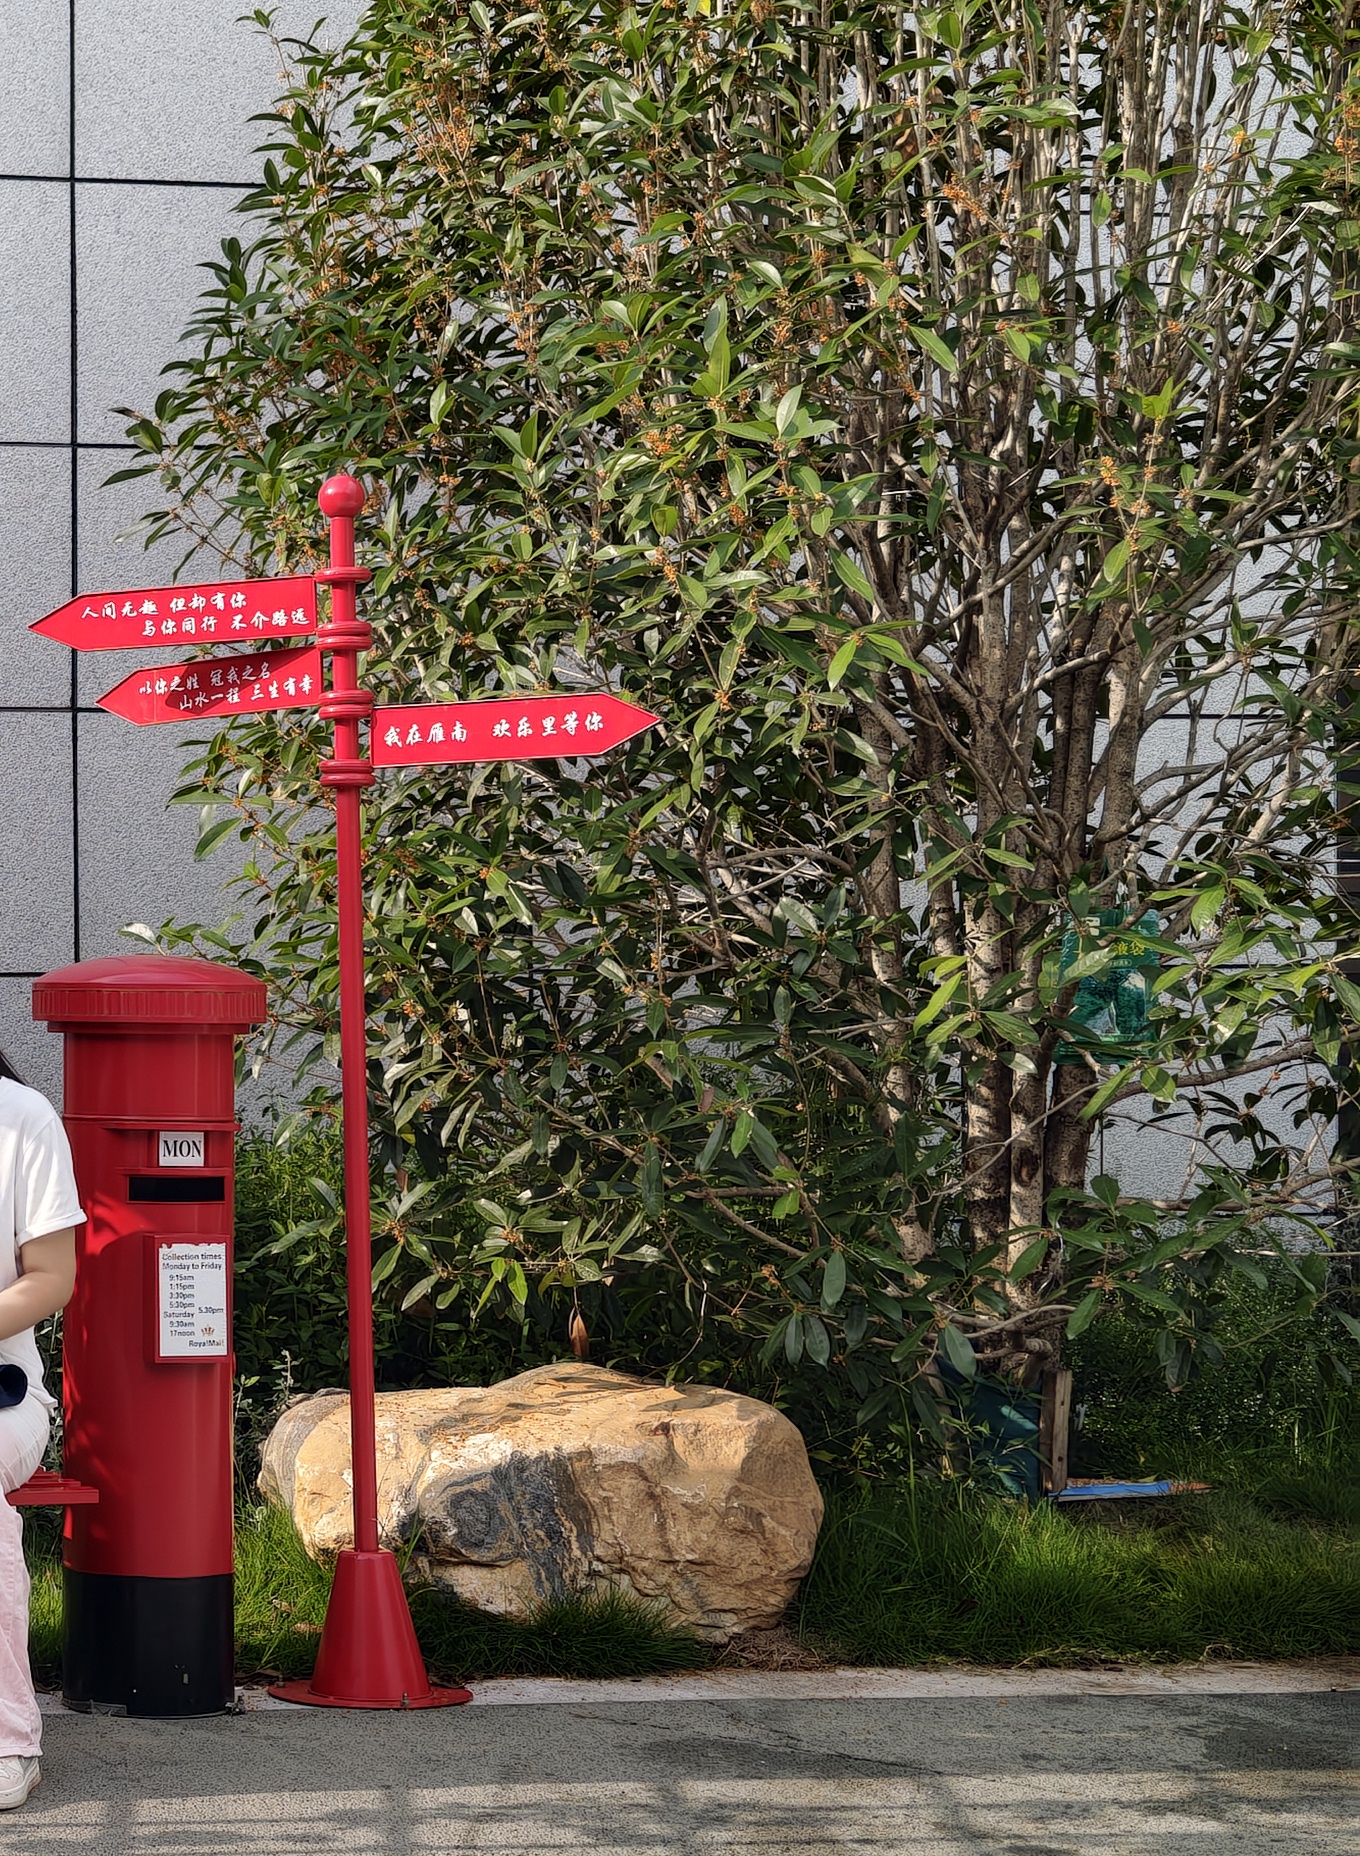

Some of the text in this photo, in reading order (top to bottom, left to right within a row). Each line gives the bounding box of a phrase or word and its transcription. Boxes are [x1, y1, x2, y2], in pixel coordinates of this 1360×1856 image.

[169, 591, 247, 615] 但却有你
[141, 615, 218, 637] 与你同行
[250, 674, 315, 701] 三生有幸
[491, 711, 605, 738] 欢乐里等你
[162, 1139, 202, 1158] MON
[162, 1252, 222, 1261] Collection times
[200, 1261, 222, 1271] Friday
